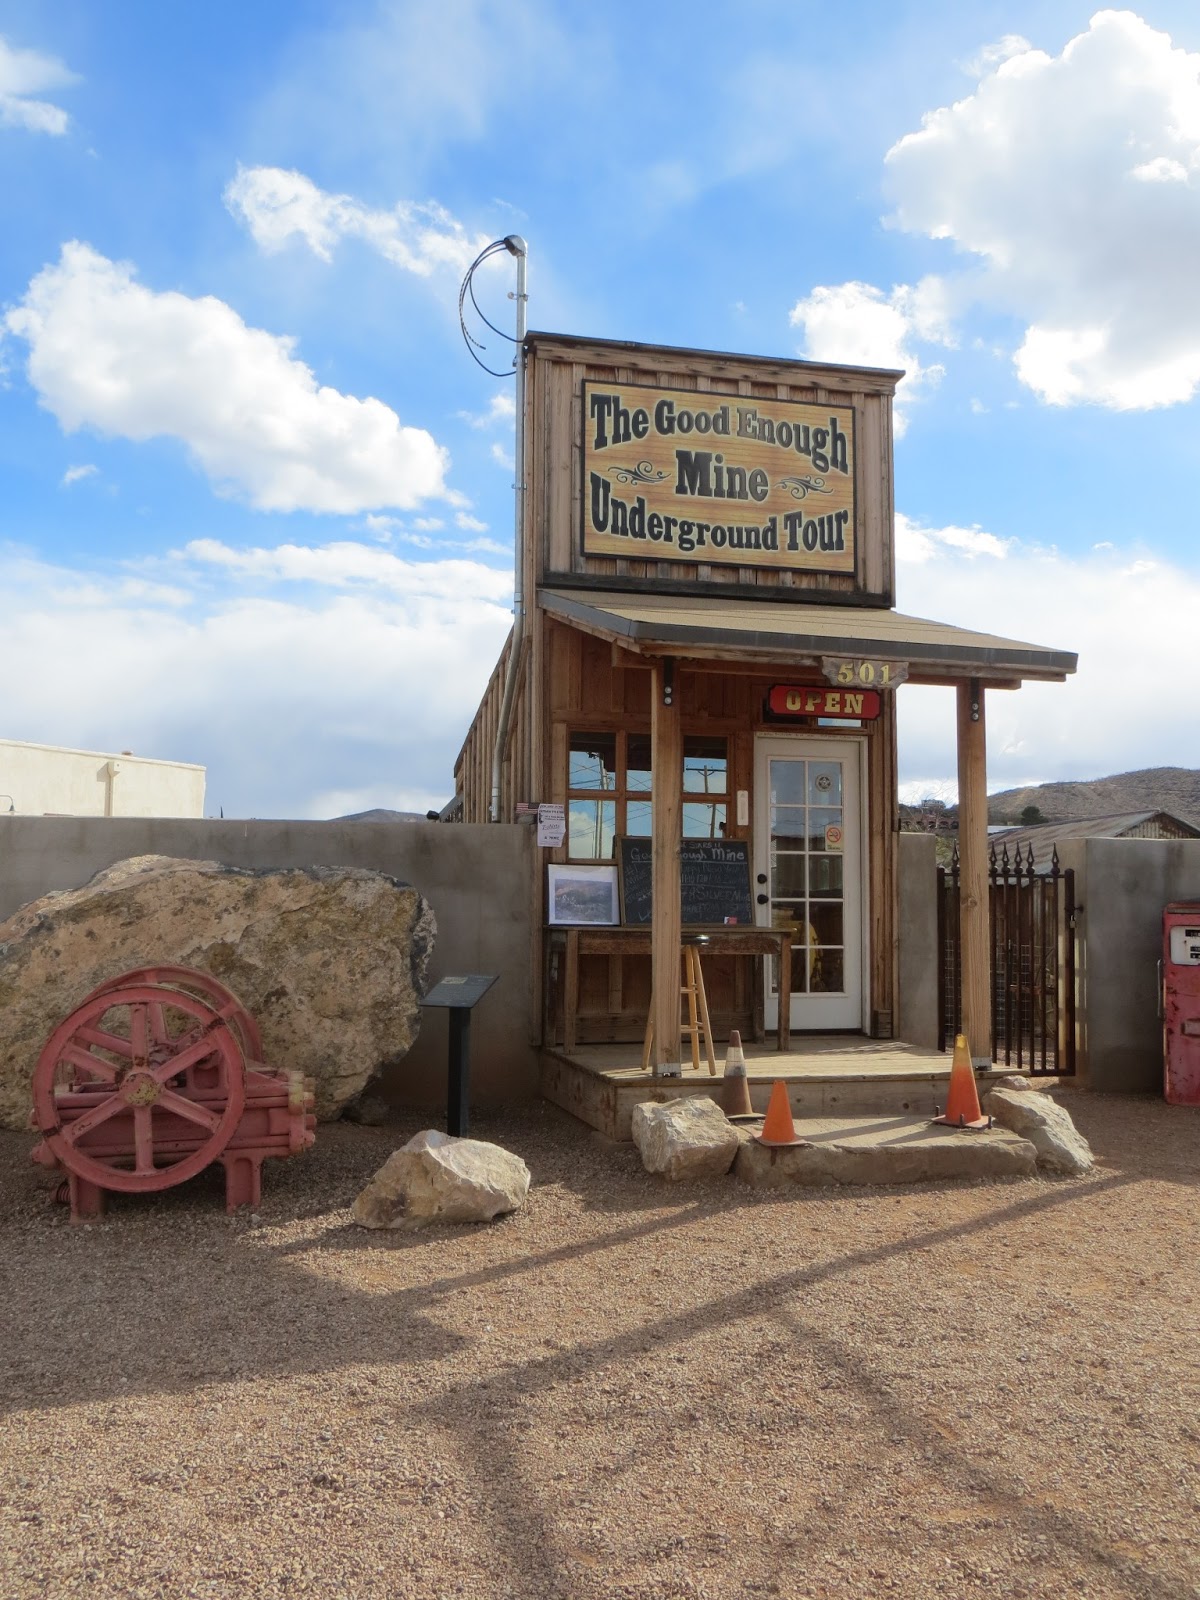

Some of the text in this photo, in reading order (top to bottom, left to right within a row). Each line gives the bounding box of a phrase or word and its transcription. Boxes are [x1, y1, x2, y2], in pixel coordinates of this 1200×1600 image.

[590, 393, 849, 475] The Good Enough
[675, 449, 769, 502] Mine
[590, 471, 849, 552] Underground Tour
[837, 662, 891, 684] 501
[786, 690, 864, 714] OPEN
[711, 847, 745, 862] Mine
